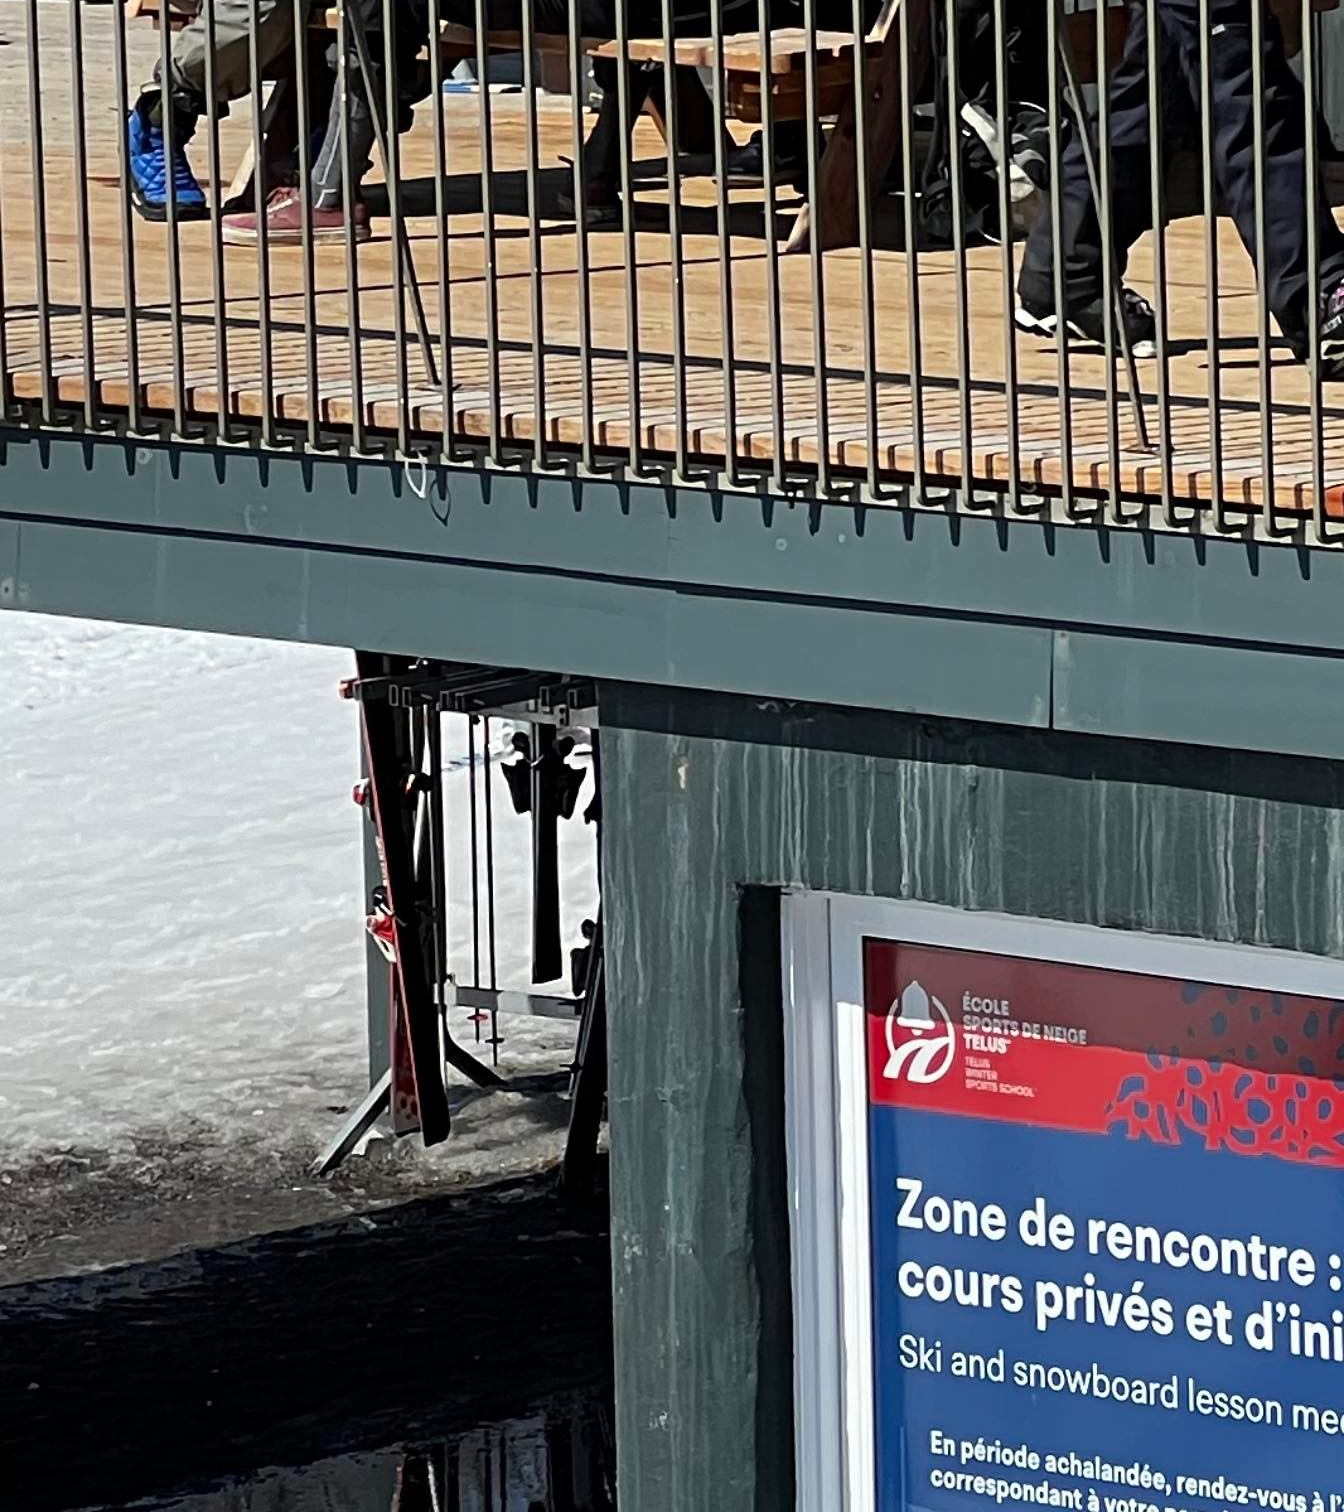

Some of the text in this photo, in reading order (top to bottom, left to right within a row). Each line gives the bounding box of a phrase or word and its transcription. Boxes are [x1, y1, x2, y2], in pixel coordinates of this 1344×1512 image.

[962, 990, 1010, 1016] ÉCOLE
[962, 1014, 1088, 1045] SPORTS DE NEIGE
[963, 1033, 1007, 1054] TELUS
[896, 1178, 1006, 1240] Zone
[1019, 1198, 1075, 1251] de
[1088, 1218, 1315, 1286] rencontre
[897, 1260, 1024, 1313] cours
[1035, 1273, 1175, 1335] privés
[1186, 1300, 1233, 1346] et
[898, 1332, 943, 1374] Ski
[951, 1349, 1006, 1384] and
[1013, 1361, 1179, 1410] snowboard
[1188, 1377, 1282, 1427] lesson
[930, 1429, 955, 1457] En
[961, 1440, 1040, 1472] période
[1045, 1451, 1173, 1497] achalandée,
[1176, 1474, 1306, 1512] rendez-vous
[1312, 1490, 1326, 1512] à
[930, 1467, 1083, 1510] correspondant
[1087, 1487, 1100, 1512] à
